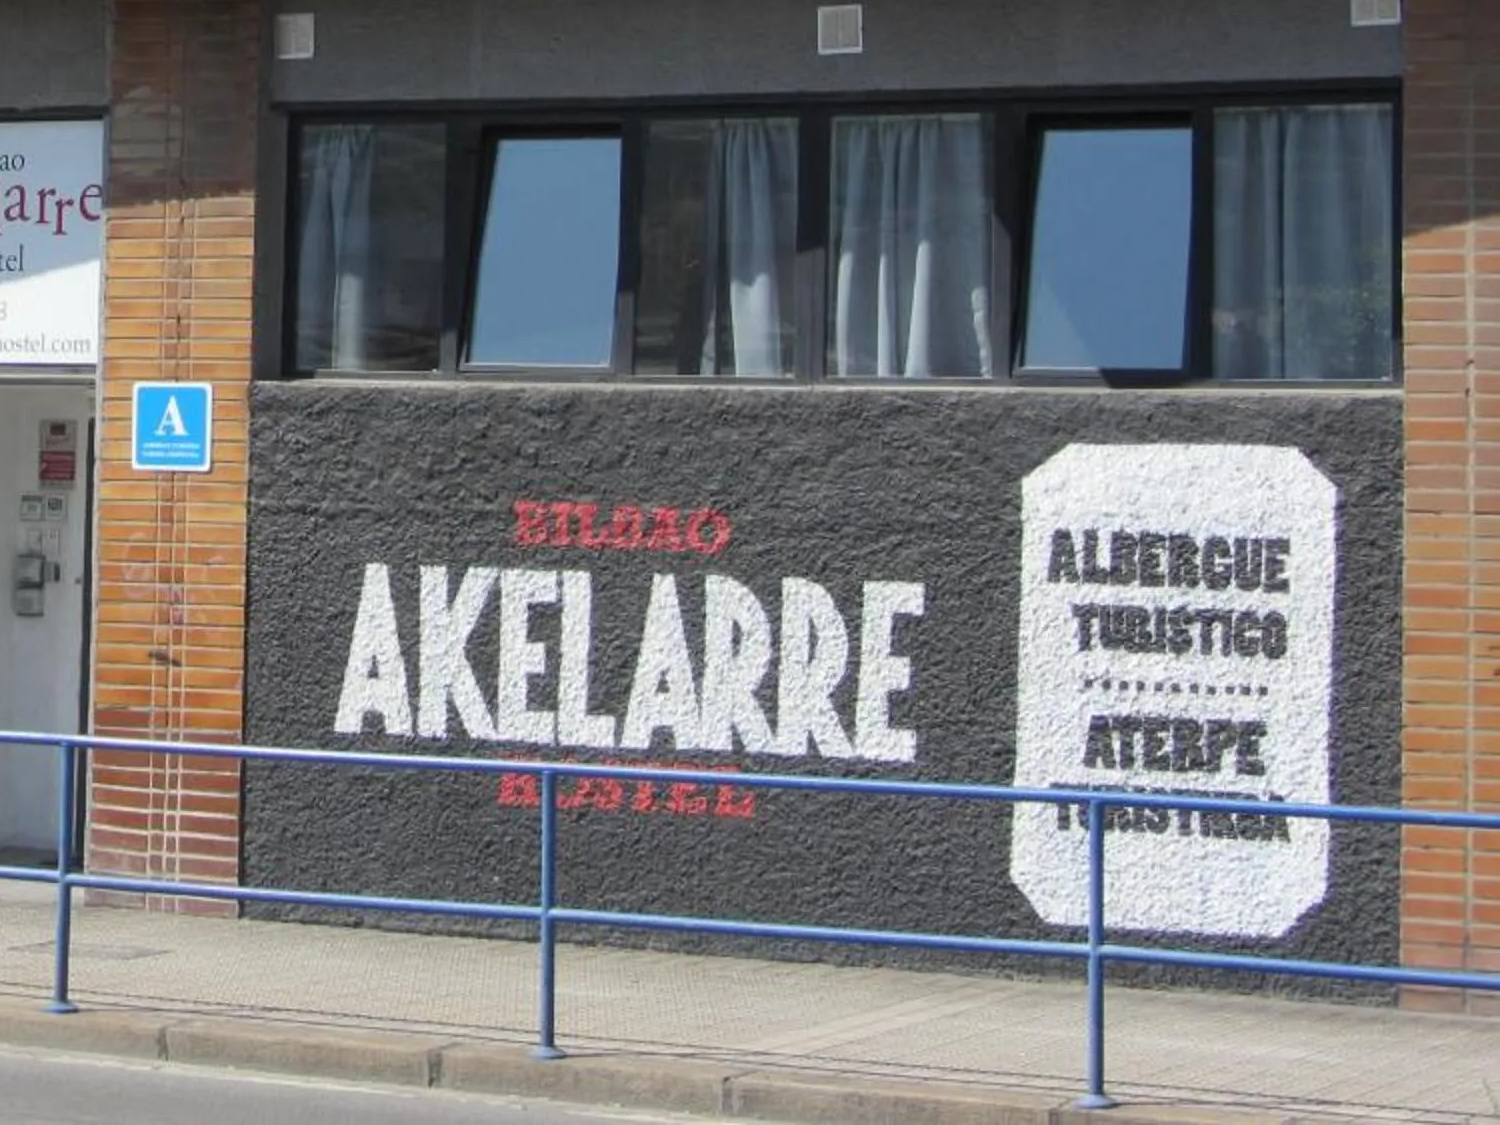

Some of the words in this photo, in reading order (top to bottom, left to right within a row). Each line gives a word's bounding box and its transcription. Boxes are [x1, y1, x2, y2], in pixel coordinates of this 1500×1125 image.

[154, 395, 189, 435] A
[513, 500, 733, 555] BILBAO
[1046, 528, 1291, 593] ALBERGUE
[1071, 602, 1288, 660] TURISTICO
[334, 562, 926, 763] AKELARRE
[1082, 714, 1268, 777] ATERPE
